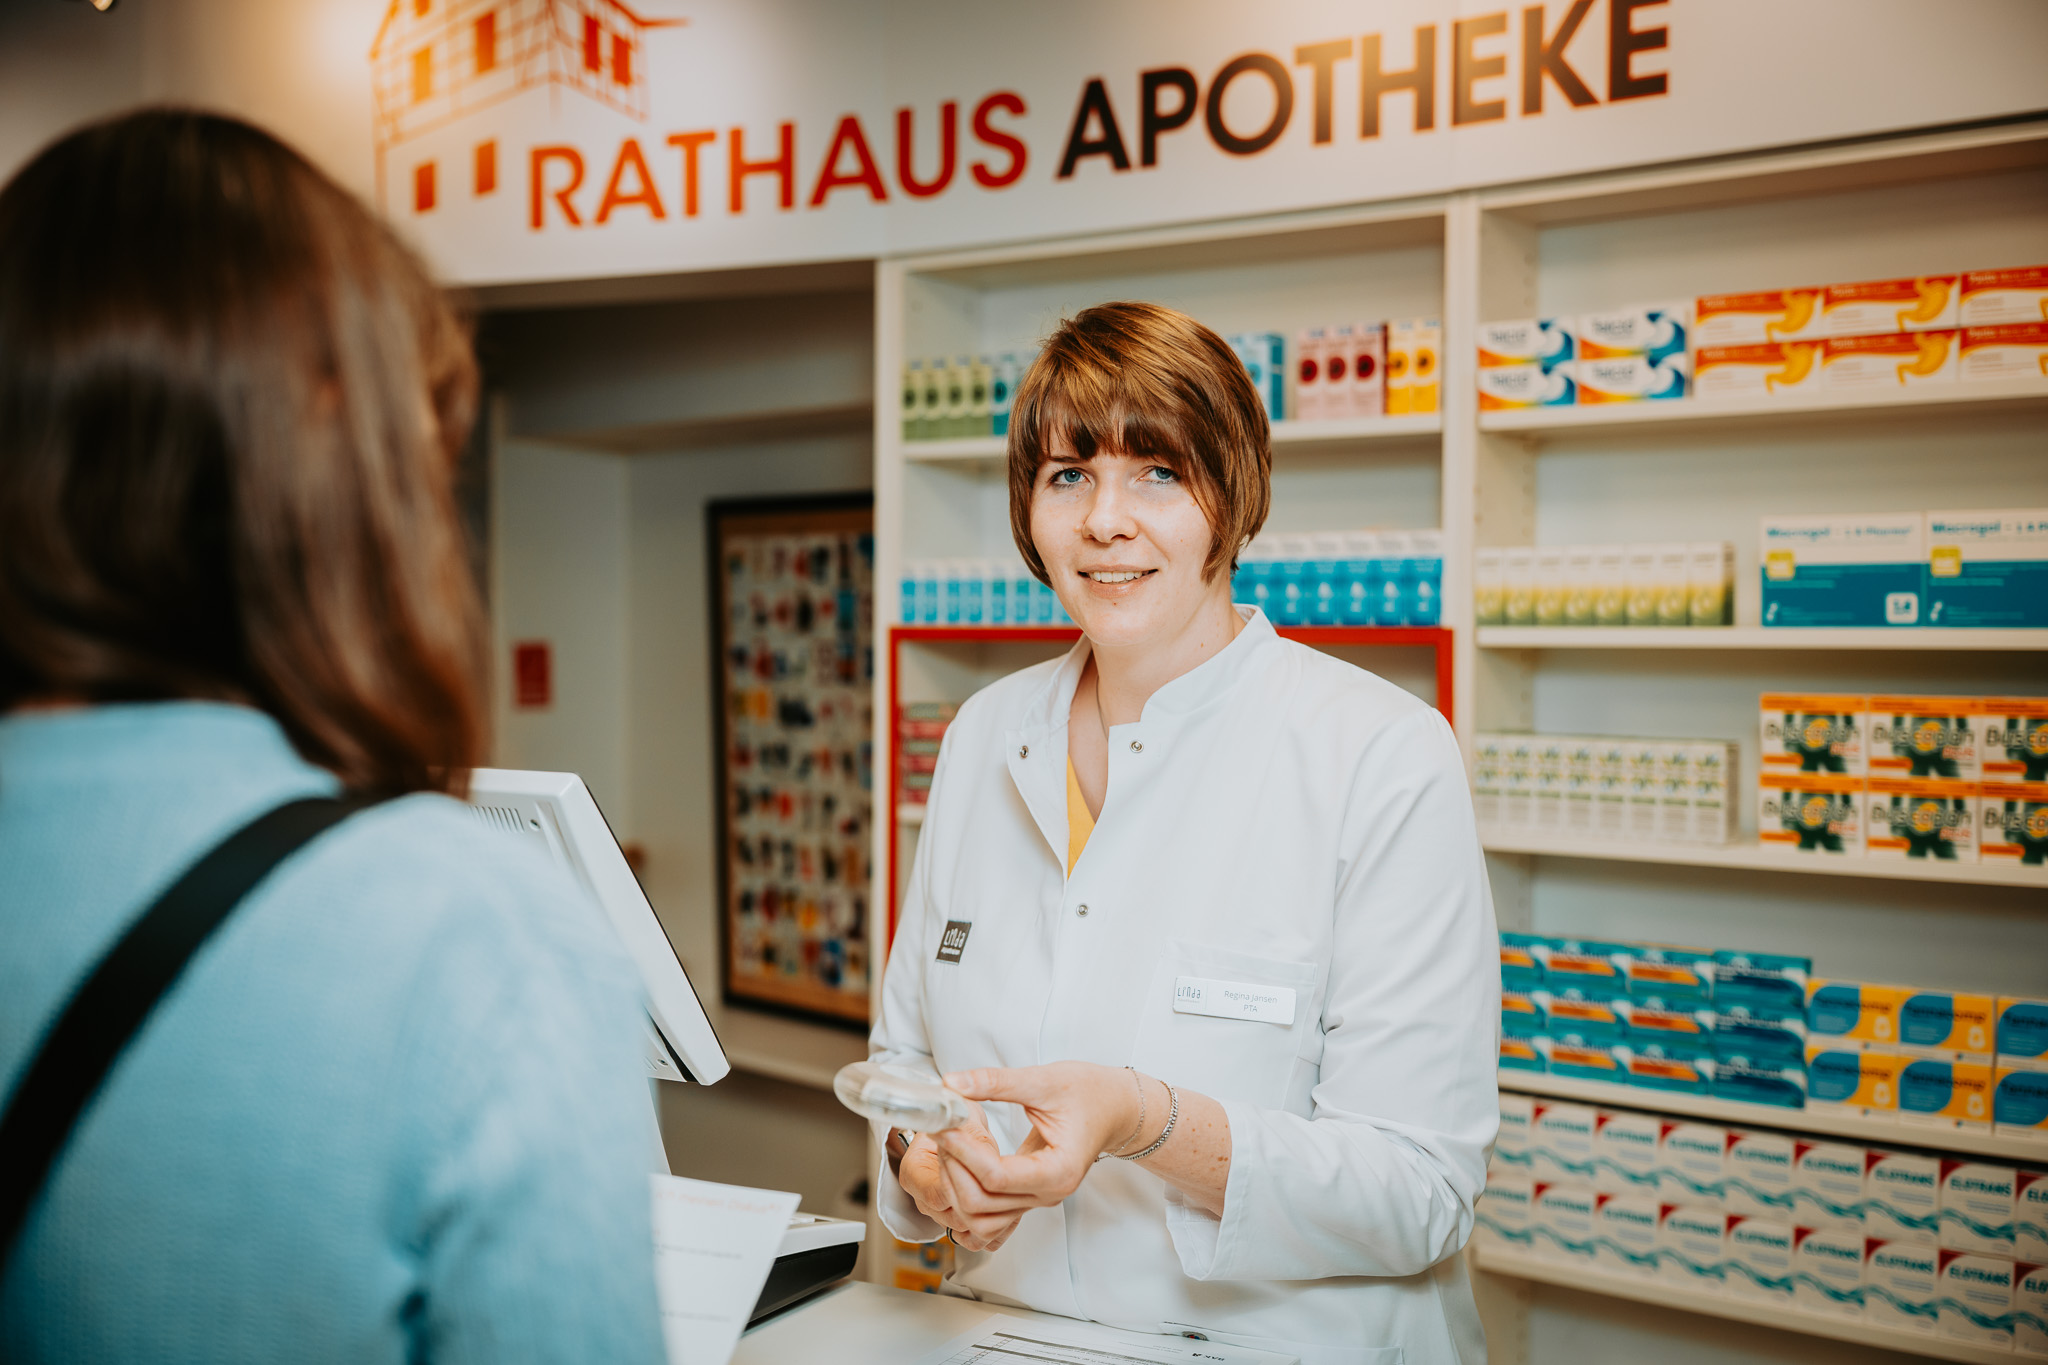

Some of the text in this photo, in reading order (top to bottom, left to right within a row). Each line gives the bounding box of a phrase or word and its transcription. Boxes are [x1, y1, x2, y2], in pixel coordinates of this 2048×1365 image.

[529, 0, 1670, 232] RATHAUS APOTHEKE
[1224, 990, 1278, 1004] Regina Jansen
[1243, 1004, 1258, 1013] PTA
[1951, 1178, 2012, 1197] ELOTRANS
[1950, 1264, 2011, 1287] ELOTRANS
